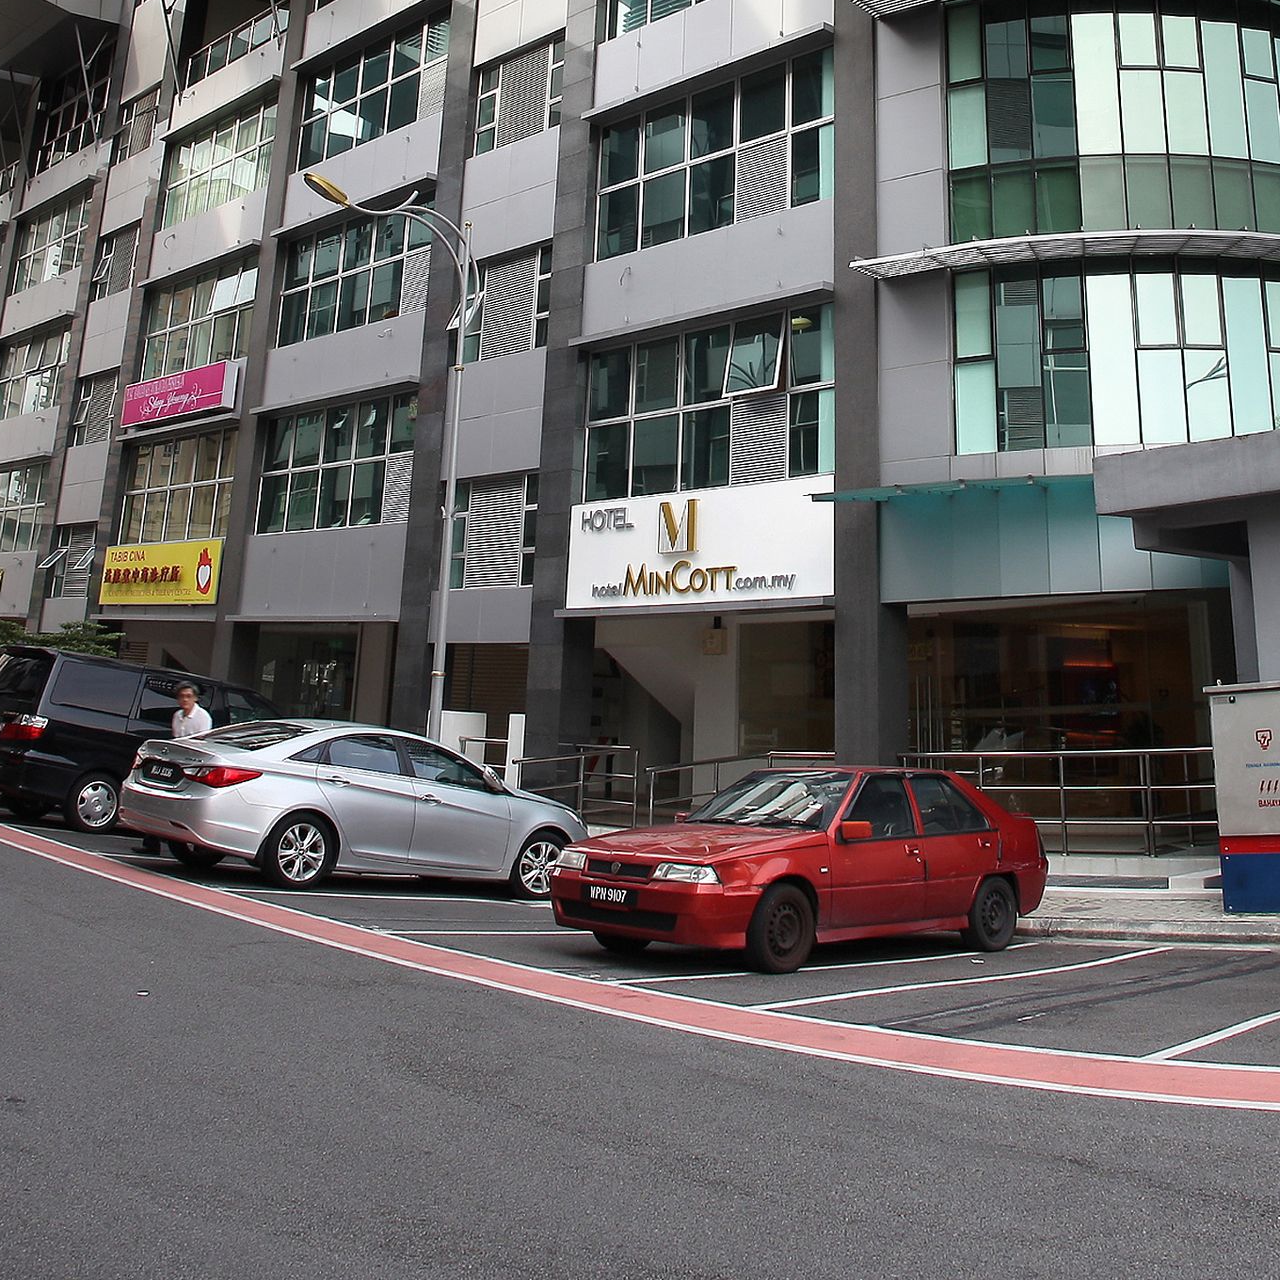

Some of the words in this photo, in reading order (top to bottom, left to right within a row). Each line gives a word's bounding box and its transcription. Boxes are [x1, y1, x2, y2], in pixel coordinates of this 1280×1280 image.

[581, 507, 635, 532] HOTEL
[110, 551, 129, 562] TABIB
[129, 550, 146, 562] CINA
[590, 885, 607, 901] WPN
[607, 888, 627, 903] 9107
